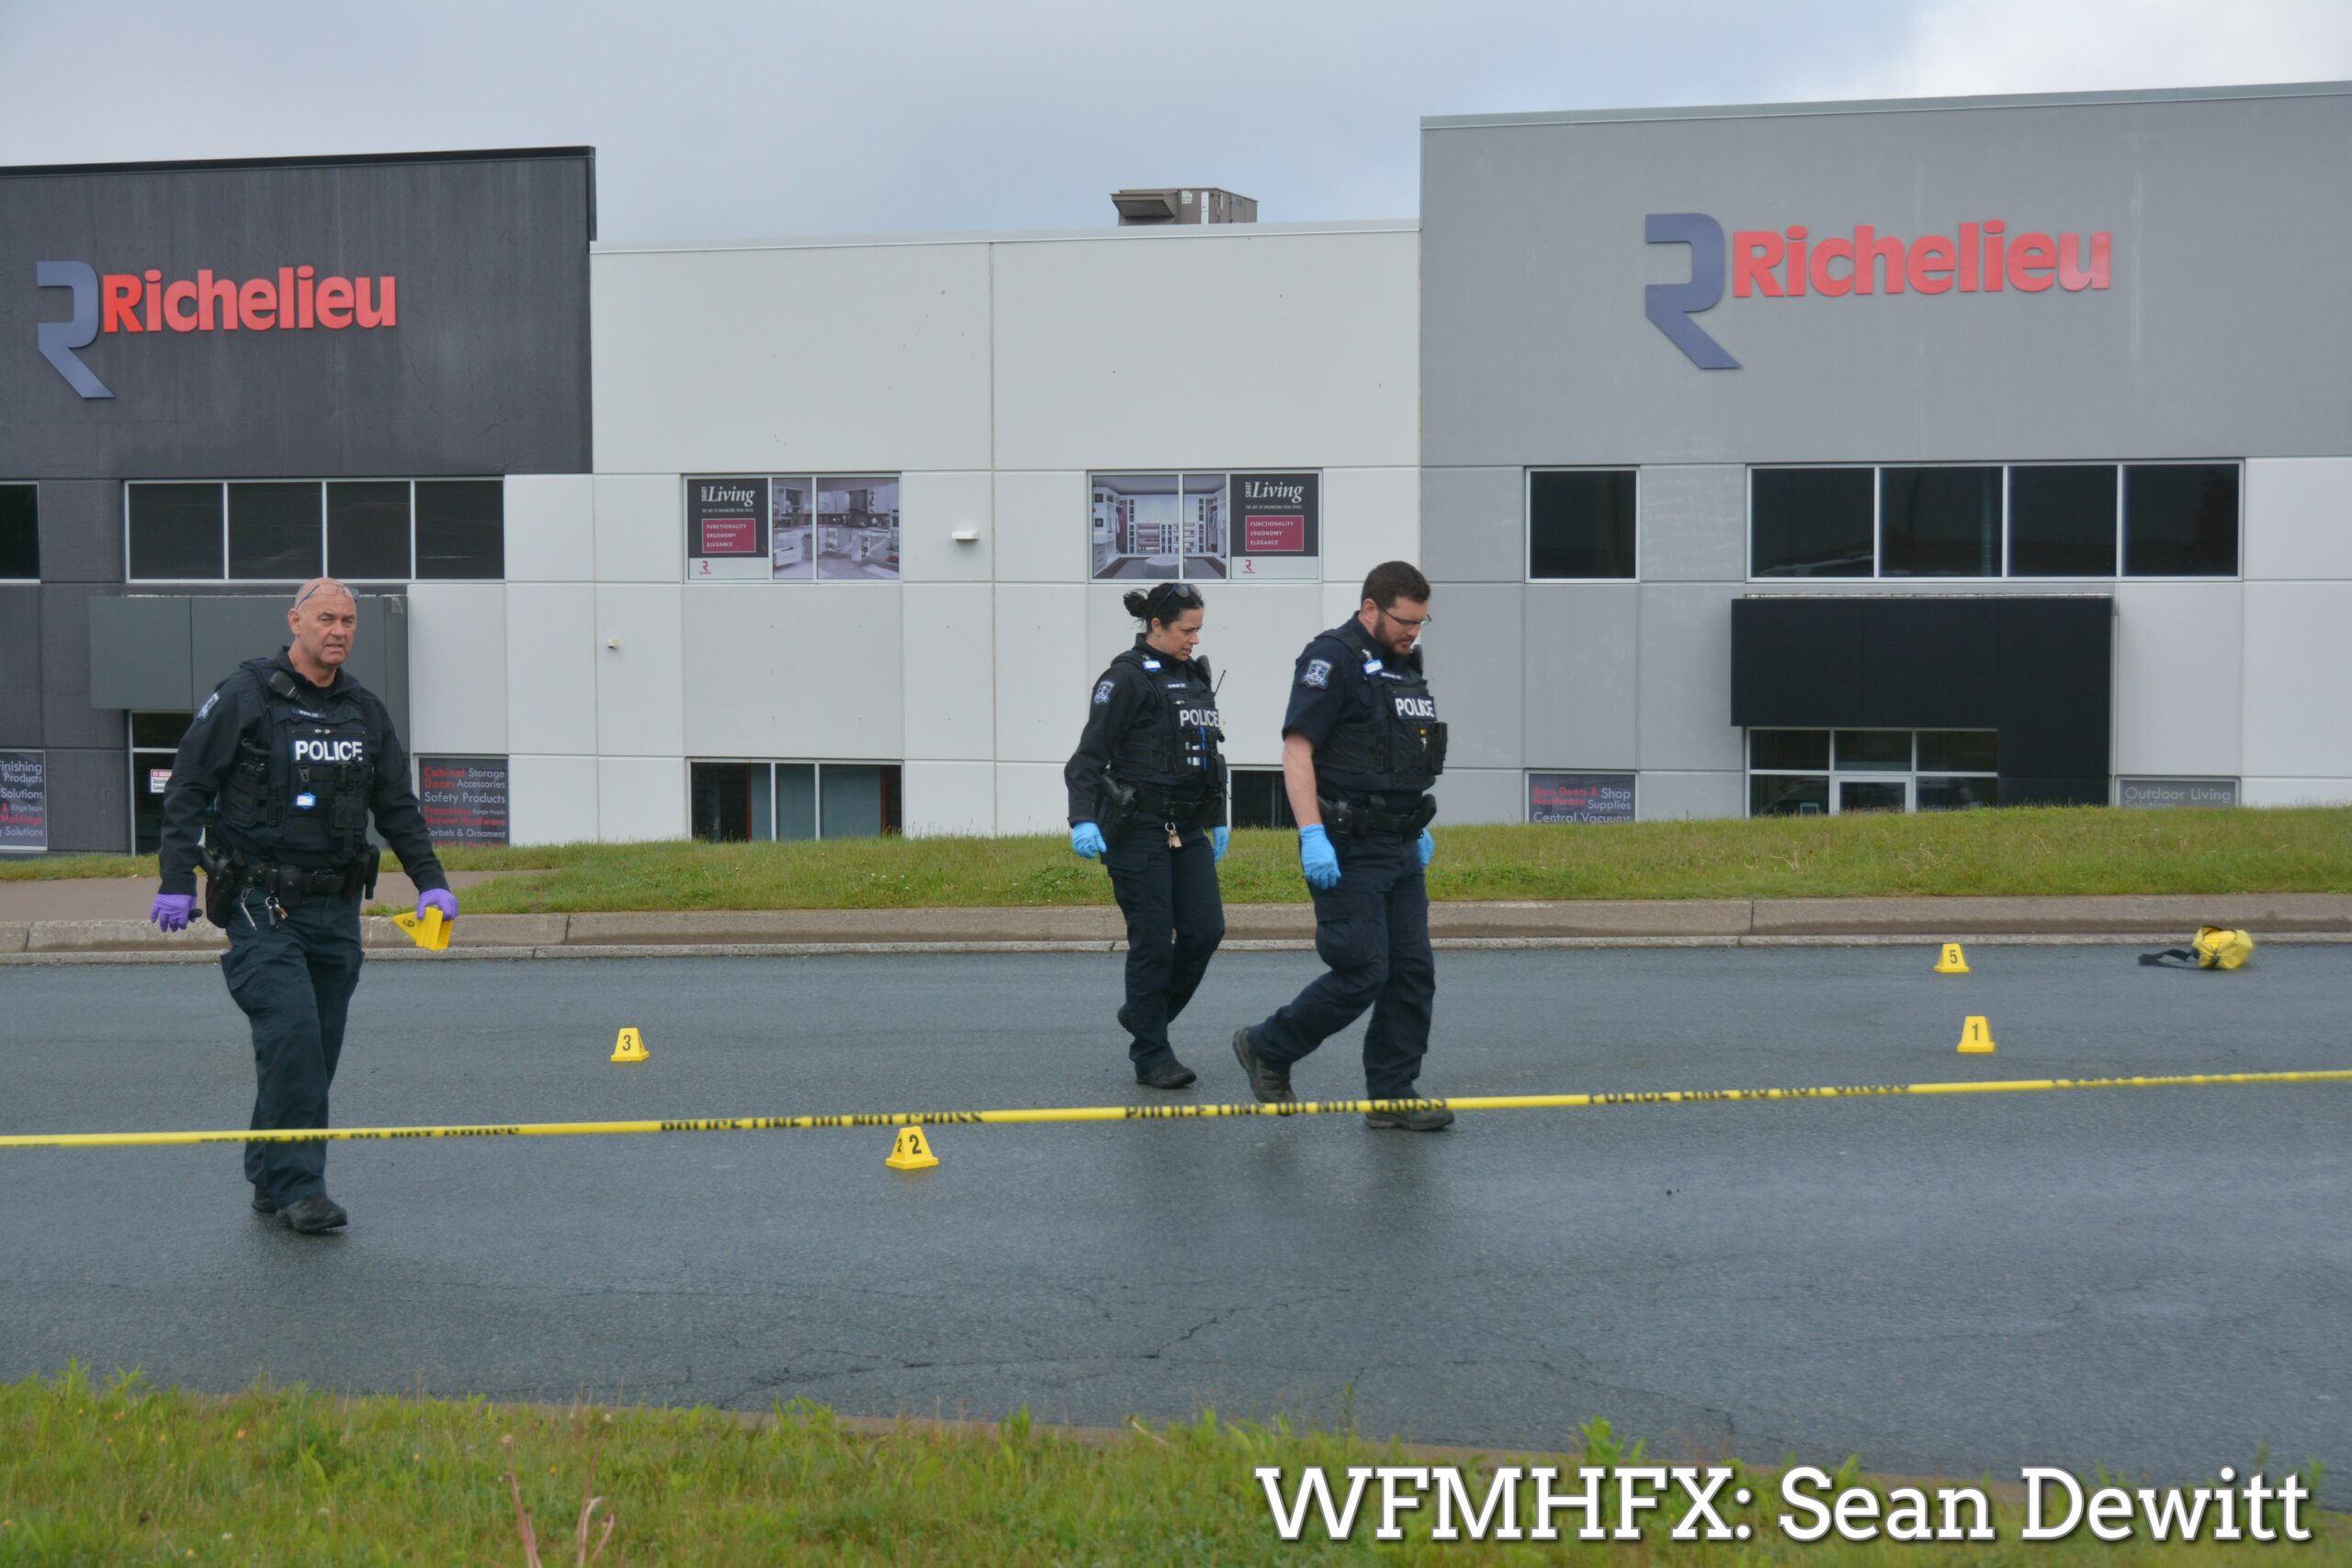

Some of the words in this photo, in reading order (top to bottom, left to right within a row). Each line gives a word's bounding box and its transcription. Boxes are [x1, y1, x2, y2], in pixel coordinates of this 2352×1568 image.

[1733, 220, 2111, 298] Richelieu
[102, 265, 397, 333] Richelieu
[707, 486, 755, 507] Living
[1251, 481, 1304, 503] Living
[1394, 697, 1435, 717] POLICE
[1180, 709, 1219, 728] POLICE
[295, 740, 363, 761] POLICE
[5, 773, 43, 783] Products
[424, 767, 466, 778] Cabinet
[469, 768, 505, 780] Storage
[424, 778, 457, 789] Doors
[457, 779, 505, 789] Accessories
[1, 787, 43, 799] Solutions
[424, 792, 458, 805] Safety
[462, 792, 505, 804] Products
[1601, 787, 1632, 801] Shop
[2124, 786, 2185, 800] Outdoor
[2190, 787, 2232, 804] Living
[1588, 799, 1632, 811] Supplies
[1533, 812, 1577, 823] Central
[1580, 812, 1632, 823] Vacuums
[6, 827, 44, 837] Solutions
[457, 828, 464, 837] &
[466, 829, 505, 838] Ornament
[1949, 949, 1958, 964] 5
[1972, 1022, 1979, 1041] 1
[622, 1034, 631, 1051] 3
[897, 1137, 902, 1153] 2
[909, 1134, 922, 1155] 2
